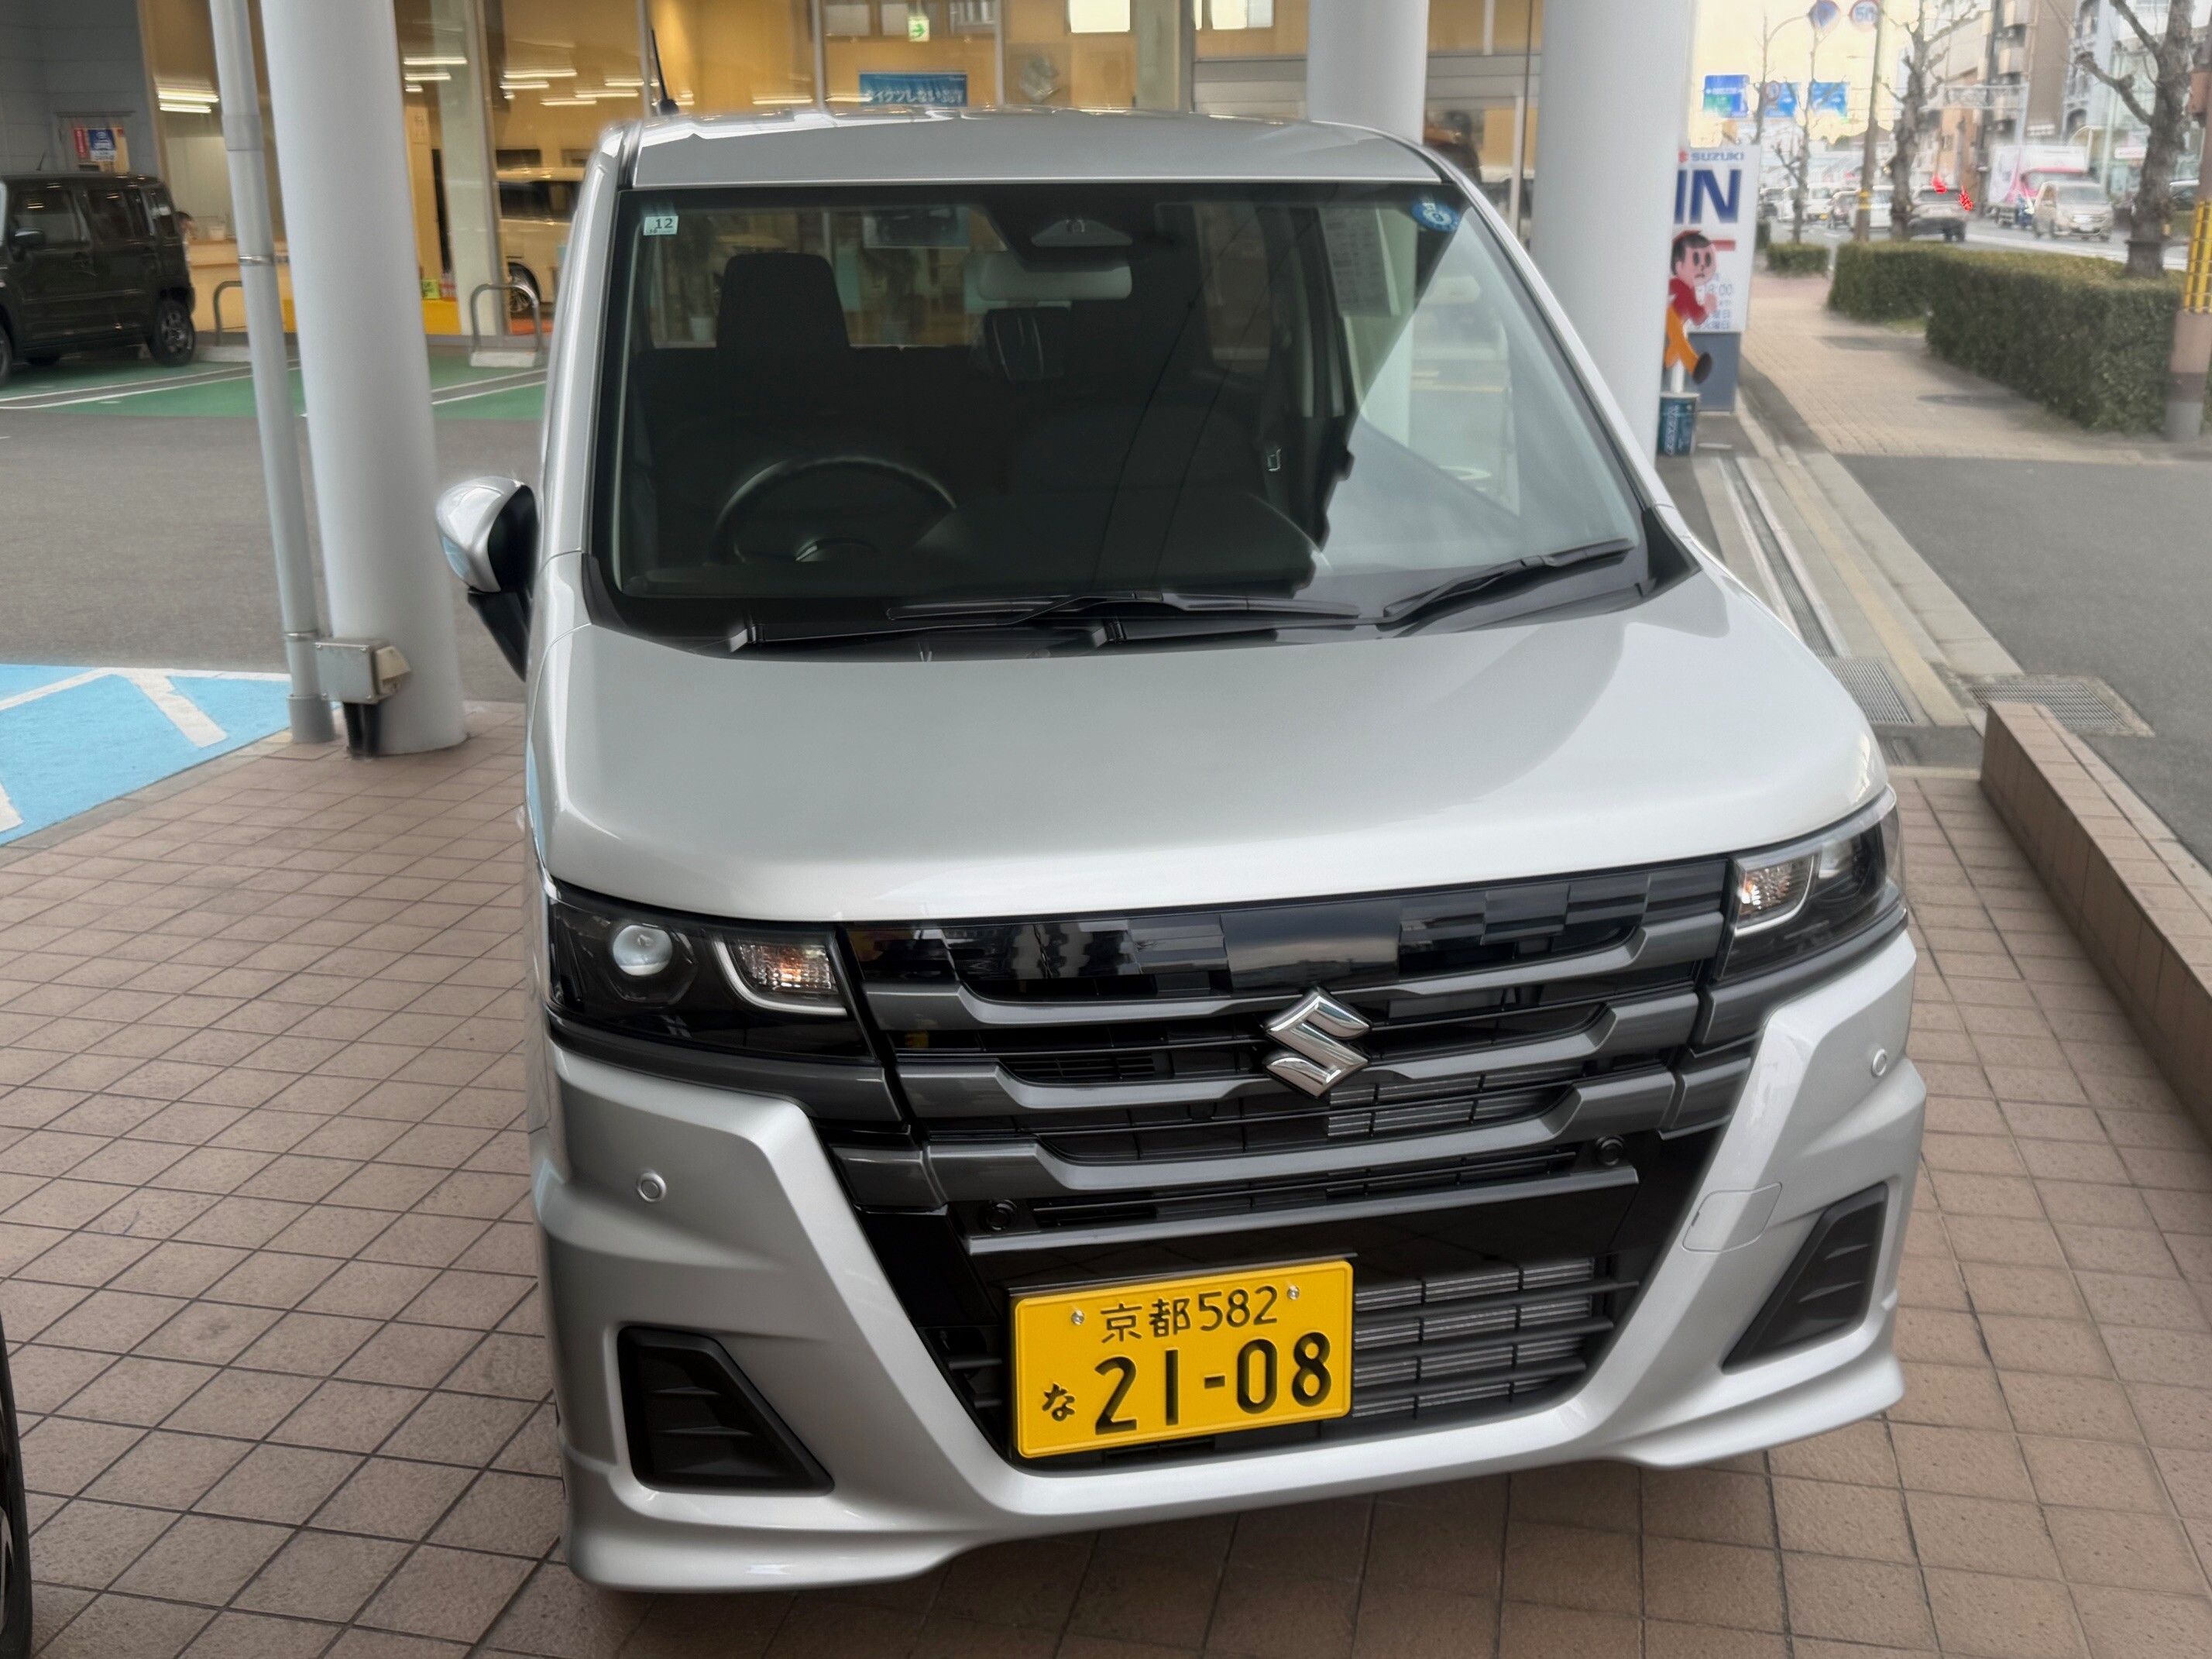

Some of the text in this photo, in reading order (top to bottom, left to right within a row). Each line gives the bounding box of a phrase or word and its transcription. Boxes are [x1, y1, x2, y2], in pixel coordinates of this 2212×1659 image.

[1691, 152, 1744, 161] SUZUKI
[1674, 169, 1741, 224] IN
[655, 218, 673, 229] 12
[1042, 1331, 1332, 1435] な 21-08
